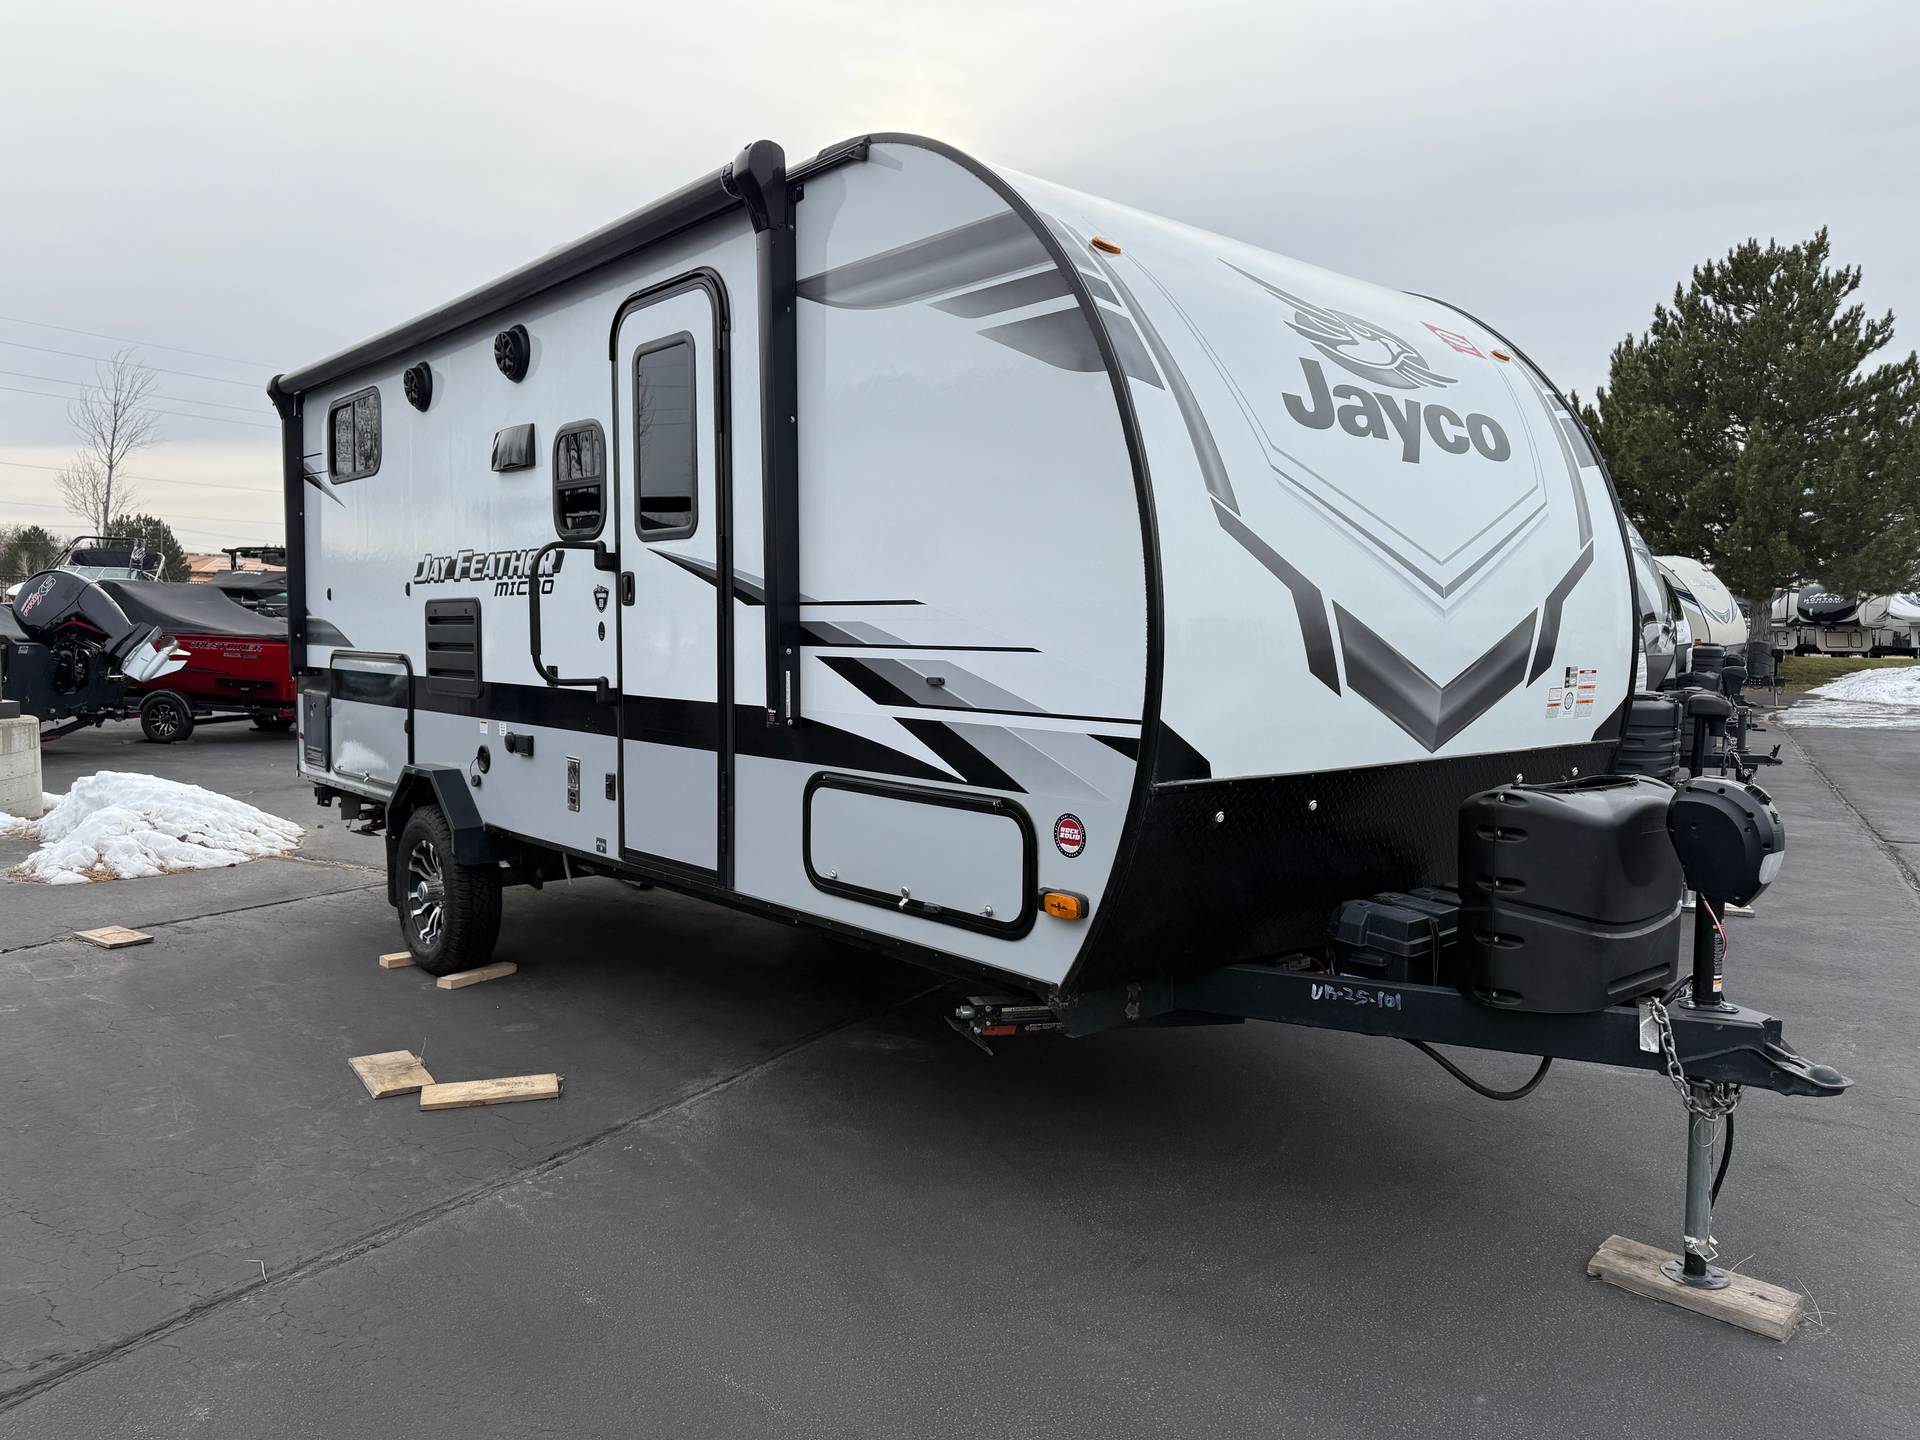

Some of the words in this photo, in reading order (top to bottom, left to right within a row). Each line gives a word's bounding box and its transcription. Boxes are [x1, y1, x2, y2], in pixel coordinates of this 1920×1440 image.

[1281, 356, 1511, 464] Jayco
[414, 553, 452, 584] JAY
[453, 548, 557, 582] FEATHER
[494, 579, 554, 597] MICO
